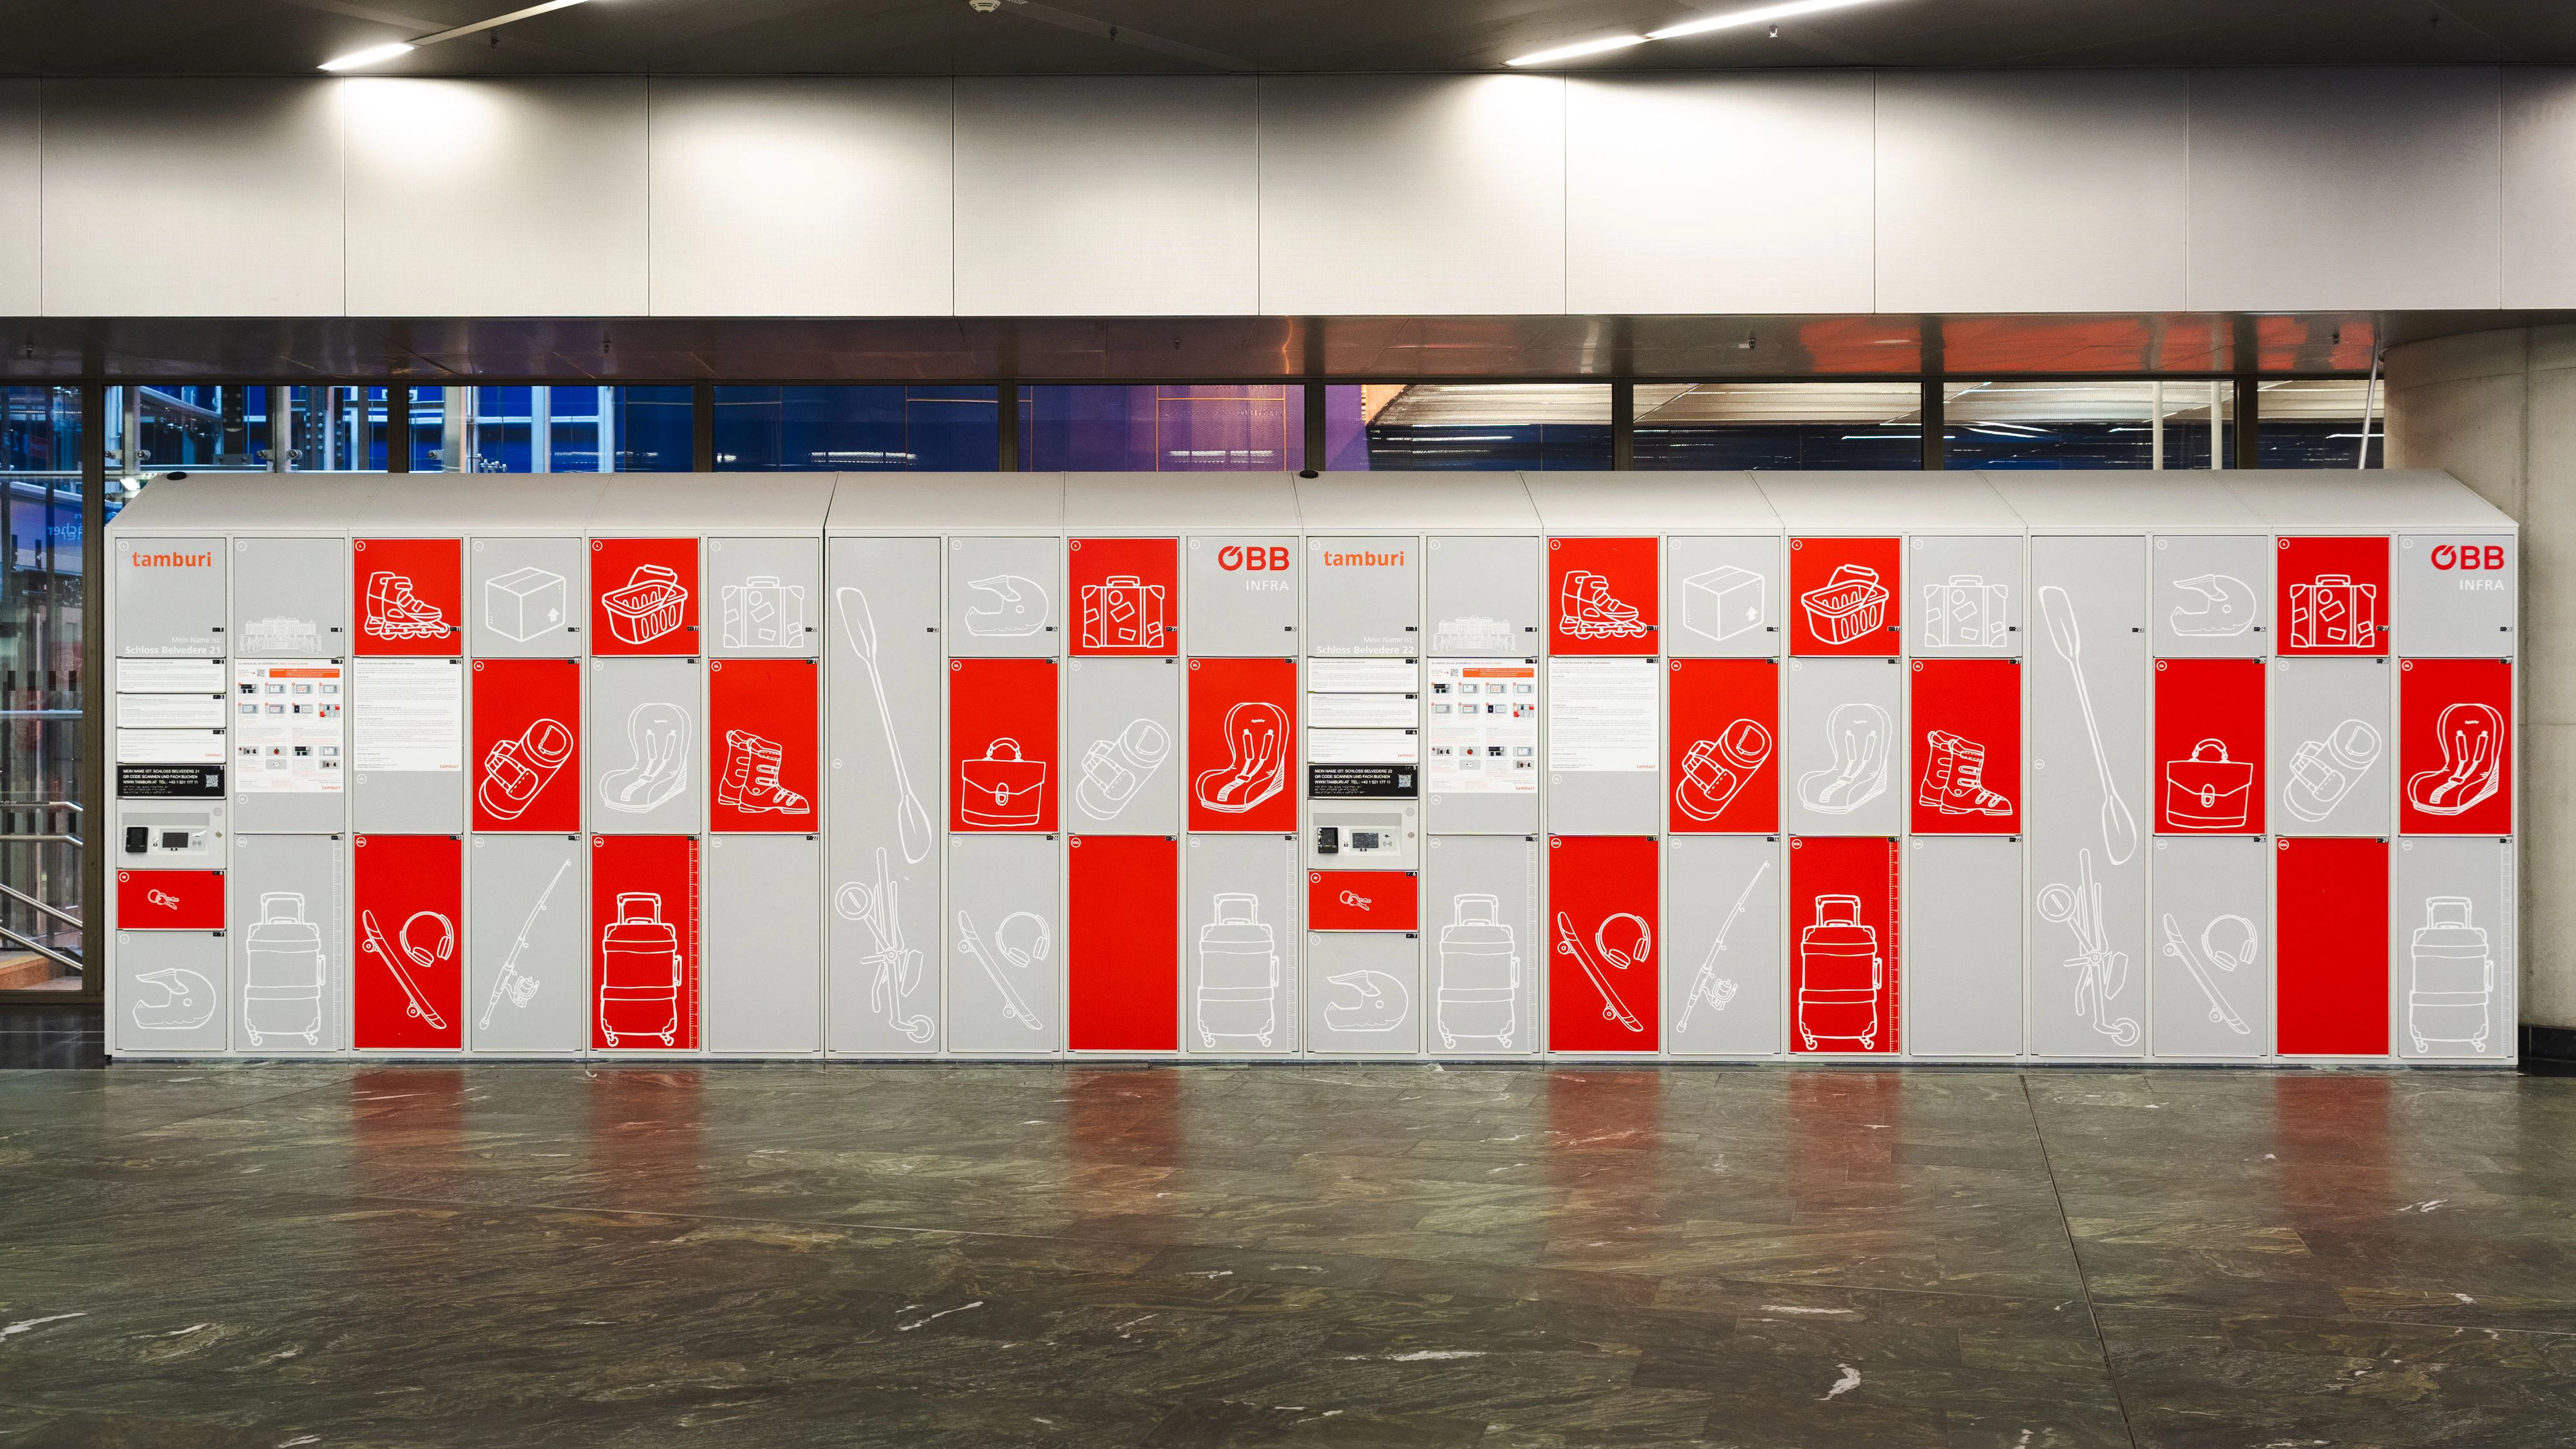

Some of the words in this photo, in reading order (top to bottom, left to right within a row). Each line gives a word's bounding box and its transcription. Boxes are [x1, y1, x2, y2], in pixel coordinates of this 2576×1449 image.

[132, 552, 211, 567] tamburi
[1218, 546, 1289, 571] ÖBB
[1323, 551, 1404, 566] tamburi
[2431, 545, 2505, 570] ÖBB
[1246, 580, 1289, 591] INFRA
[2460, 580, 2504, 591] INFRA
[125, 646, 159, 654] Schloss
[162, 646, 207, 654] Belvedere
[209, 646, 220, 654] 21
[1316, 646, 1350, 654] Schloss
[1354, 646, 1399, 654] Belvedere
[1402, 646, 1414, 654] 22
